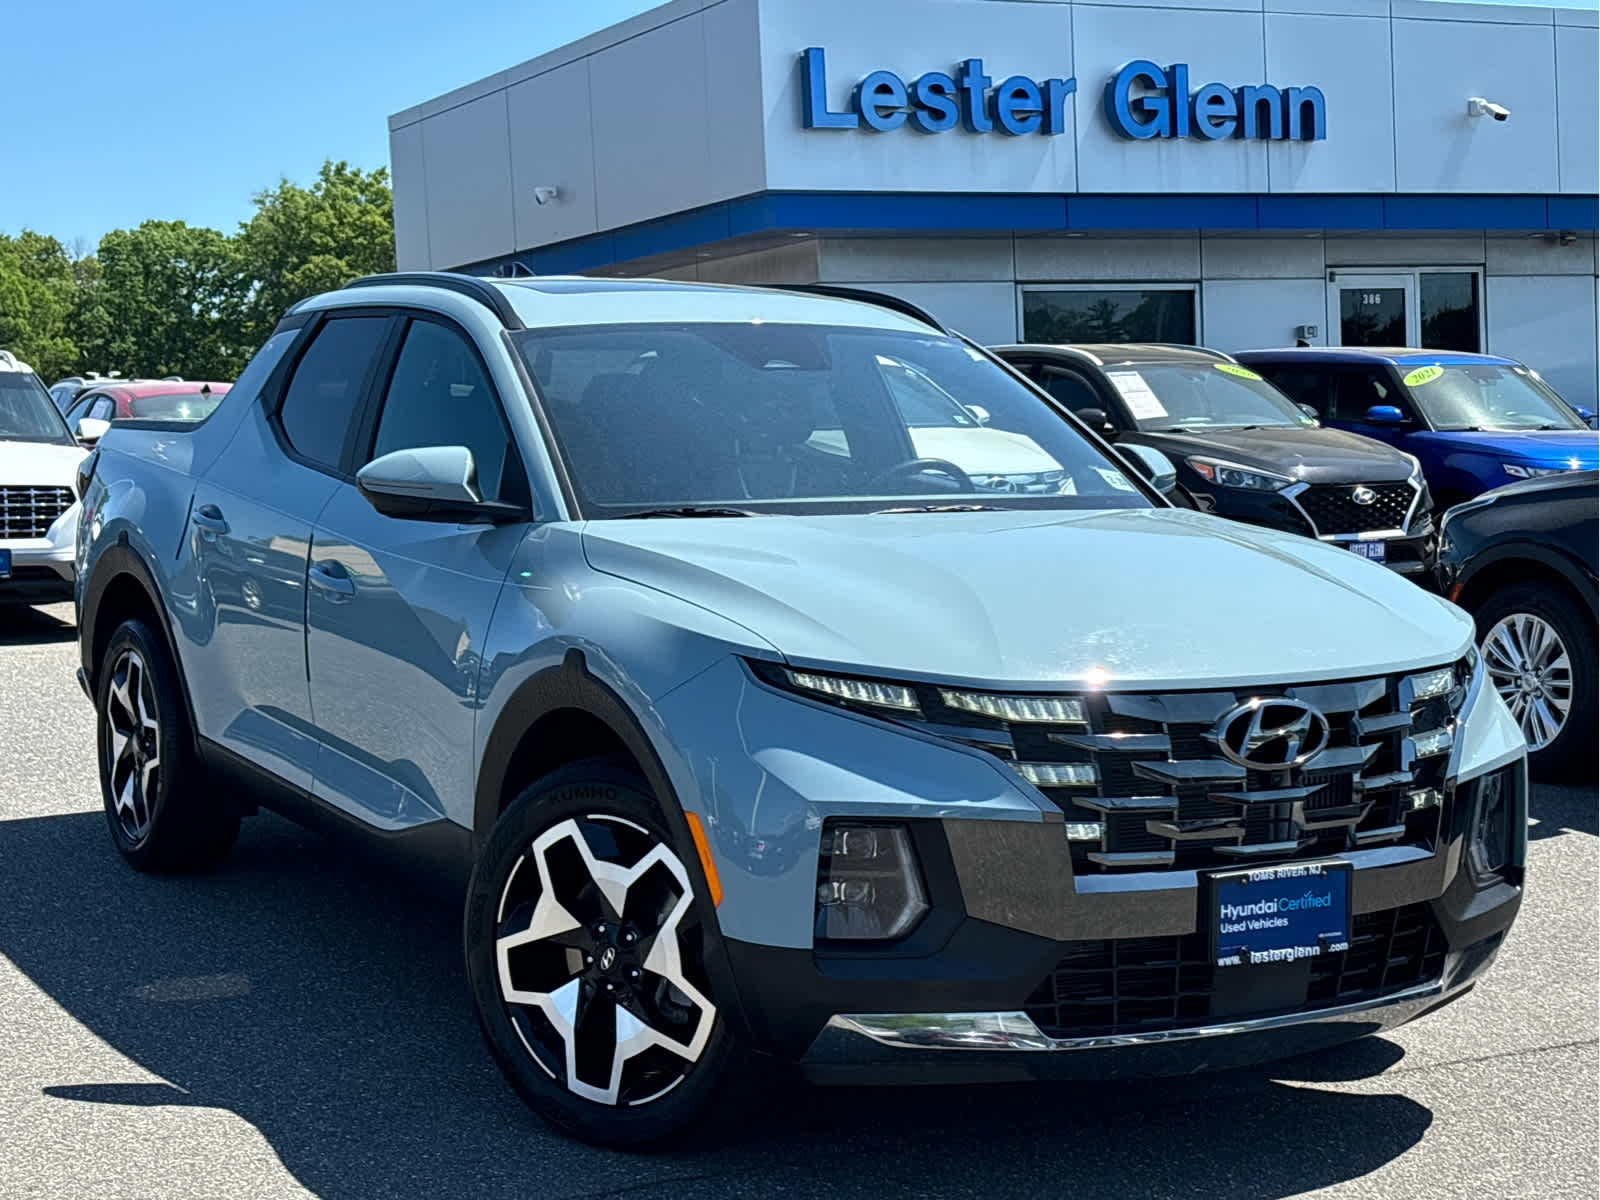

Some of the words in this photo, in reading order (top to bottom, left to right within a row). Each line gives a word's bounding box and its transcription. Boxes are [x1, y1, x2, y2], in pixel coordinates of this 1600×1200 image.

[801, 47, 1076, 136] Lester
[1106, 59, 1327, 141] Glenn
[549, 784, 617, 804] KUMHO
[1249, 871, 1275, 882] TOMS
[1309, 865, 1321, 875] NJ
[1220, 898, 1278, 920] Hyundai
[1278, 892, 1331, 912] Certified
[1220, 921, 1246, 933] Used
[1248, 917, 1288, 931] Vehicles
[1250, 945, 1321, 964] lesterglenn
[1328, 942, 1349, 952] .com
